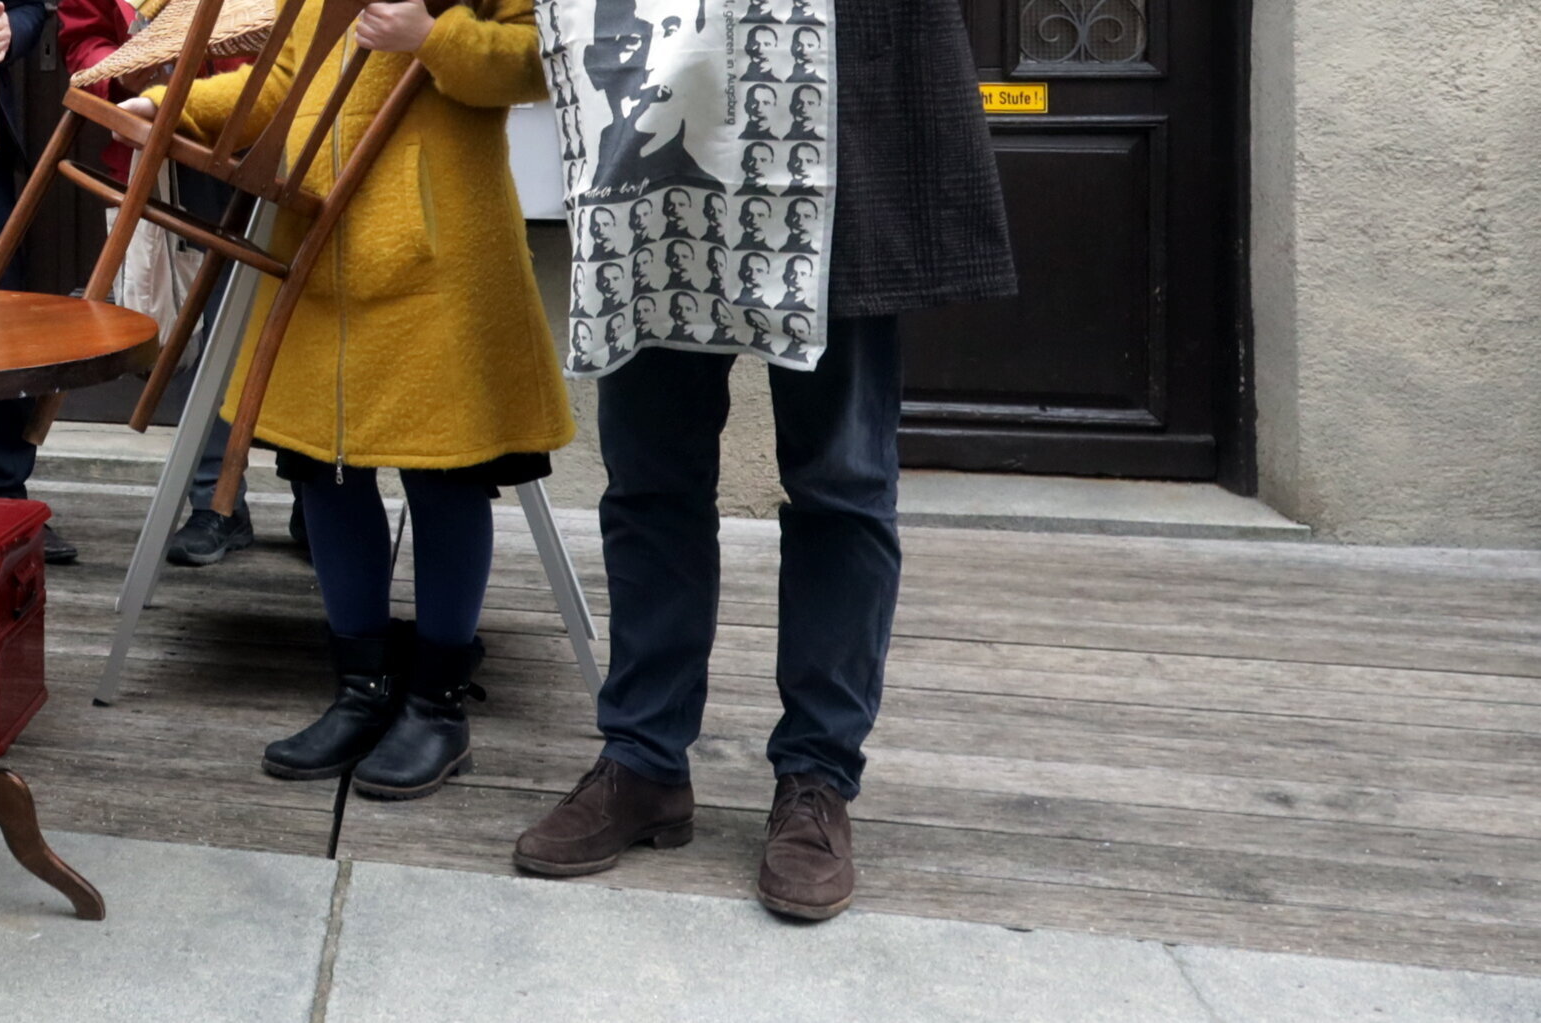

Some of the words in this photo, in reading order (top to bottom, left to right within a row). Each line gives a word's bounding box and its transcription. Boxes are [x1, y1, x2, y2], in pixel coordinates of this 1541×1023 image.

[722, 10, 736, 56] geboren
[726, 60, 736, 69] in
[724, 74, 737, 126] Augsburg
[999, 91, 1031, 105] Stufe
